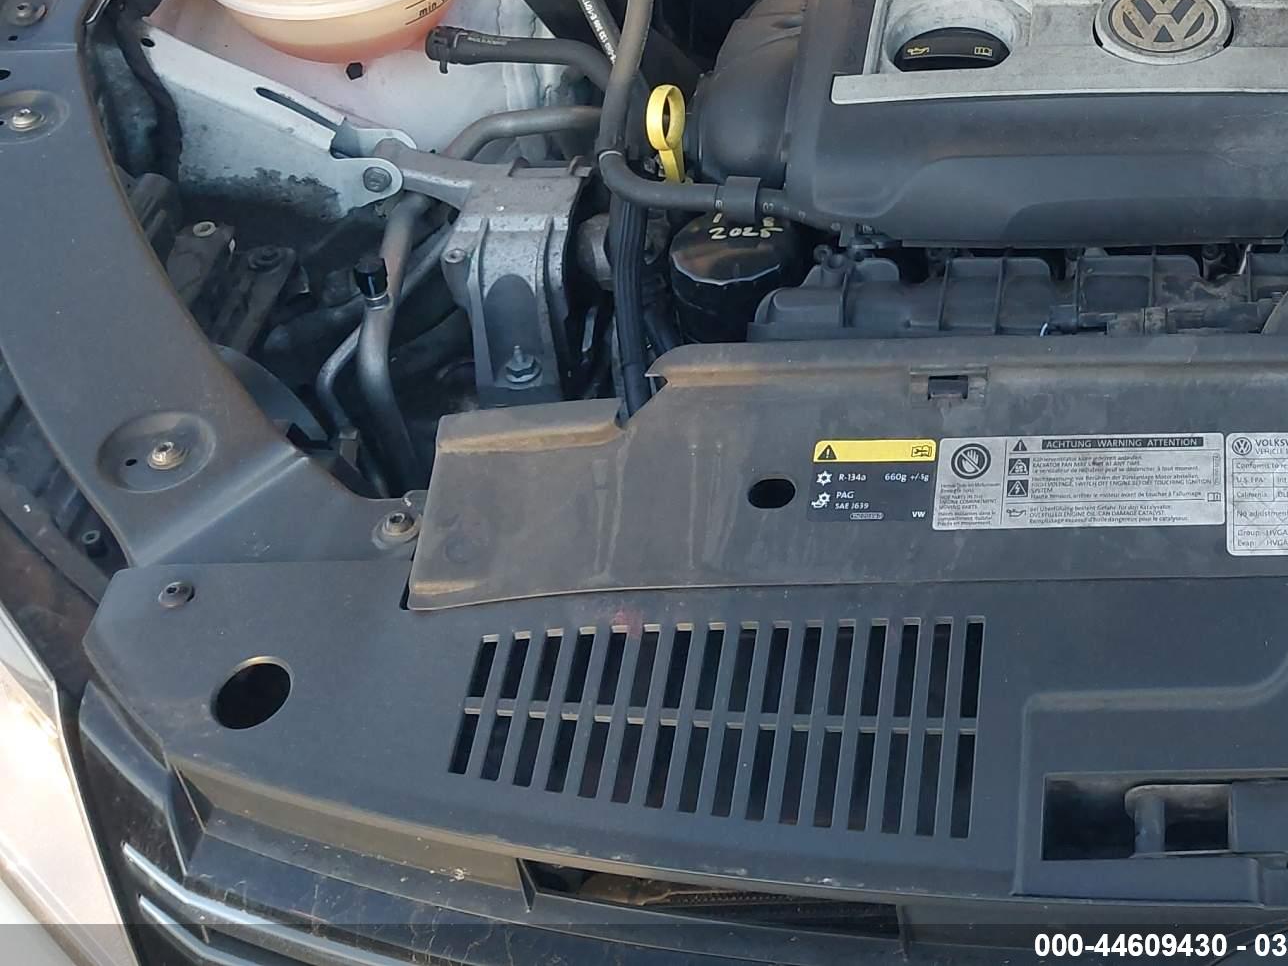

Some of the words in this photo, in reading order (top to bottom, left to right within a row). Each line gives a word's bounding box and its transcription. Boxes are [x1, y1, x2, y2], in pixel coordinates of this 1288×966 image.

[1046, 440, 1092, 448] ACHTUNG
[1097, 439, 1142, 447] WARNING
[1147, 438, 1197, 446] ATTENTION
[838, 473, 866, 482] R-134a
[884, 473, 907, 482] 660g
[836, 491, 854, 499] PAG
